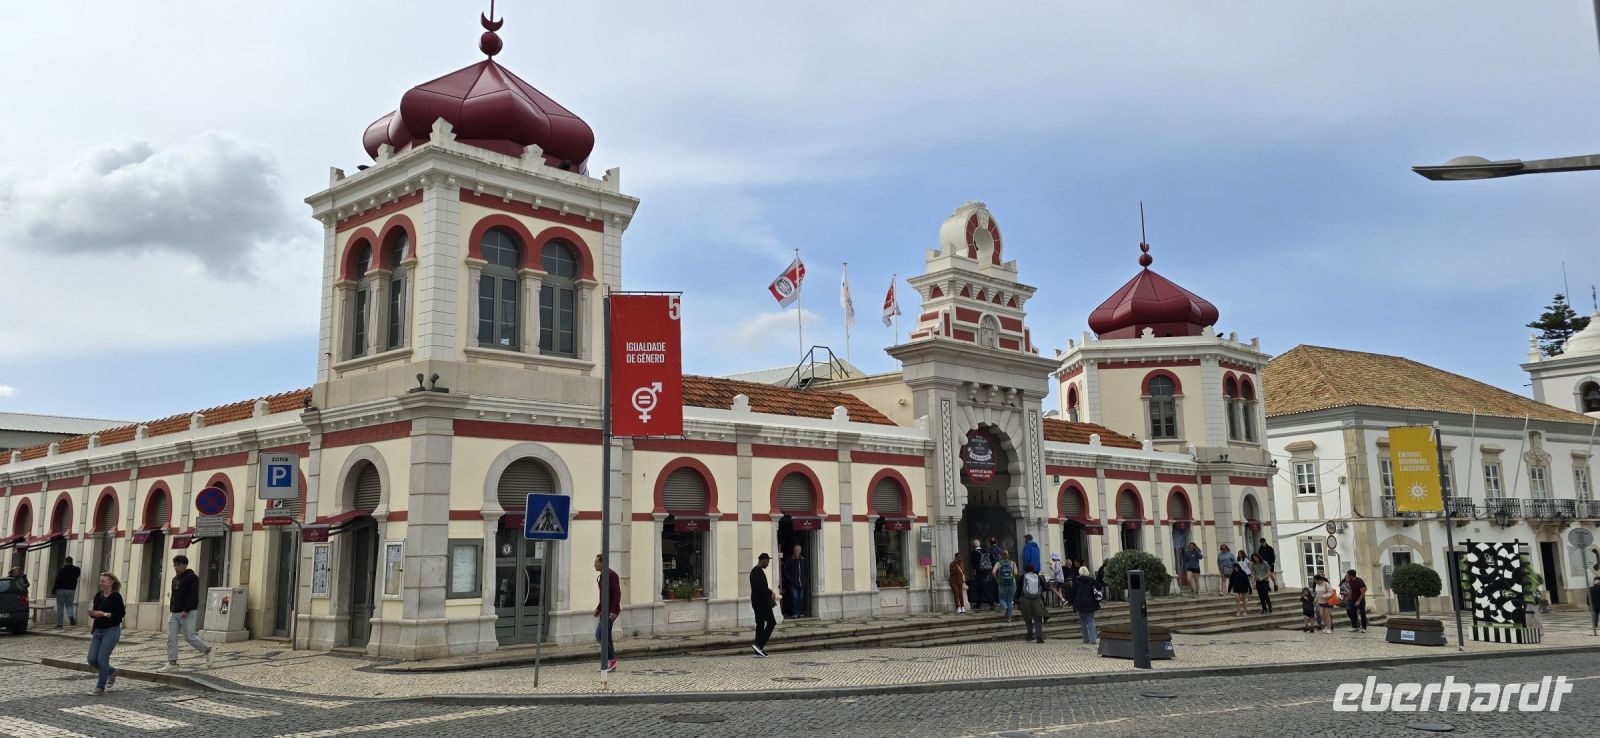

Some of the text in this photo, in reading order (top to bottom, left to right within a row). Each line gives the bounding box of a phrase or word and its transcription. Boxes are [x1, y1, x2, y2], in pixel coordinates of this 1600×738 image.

[668, 294, 681, 321] 5
[626, 342, 666, 352] IGUALDADE
[626, 352, 665, 364] DE GÉNERO
[272, 466, 287, 486] P
